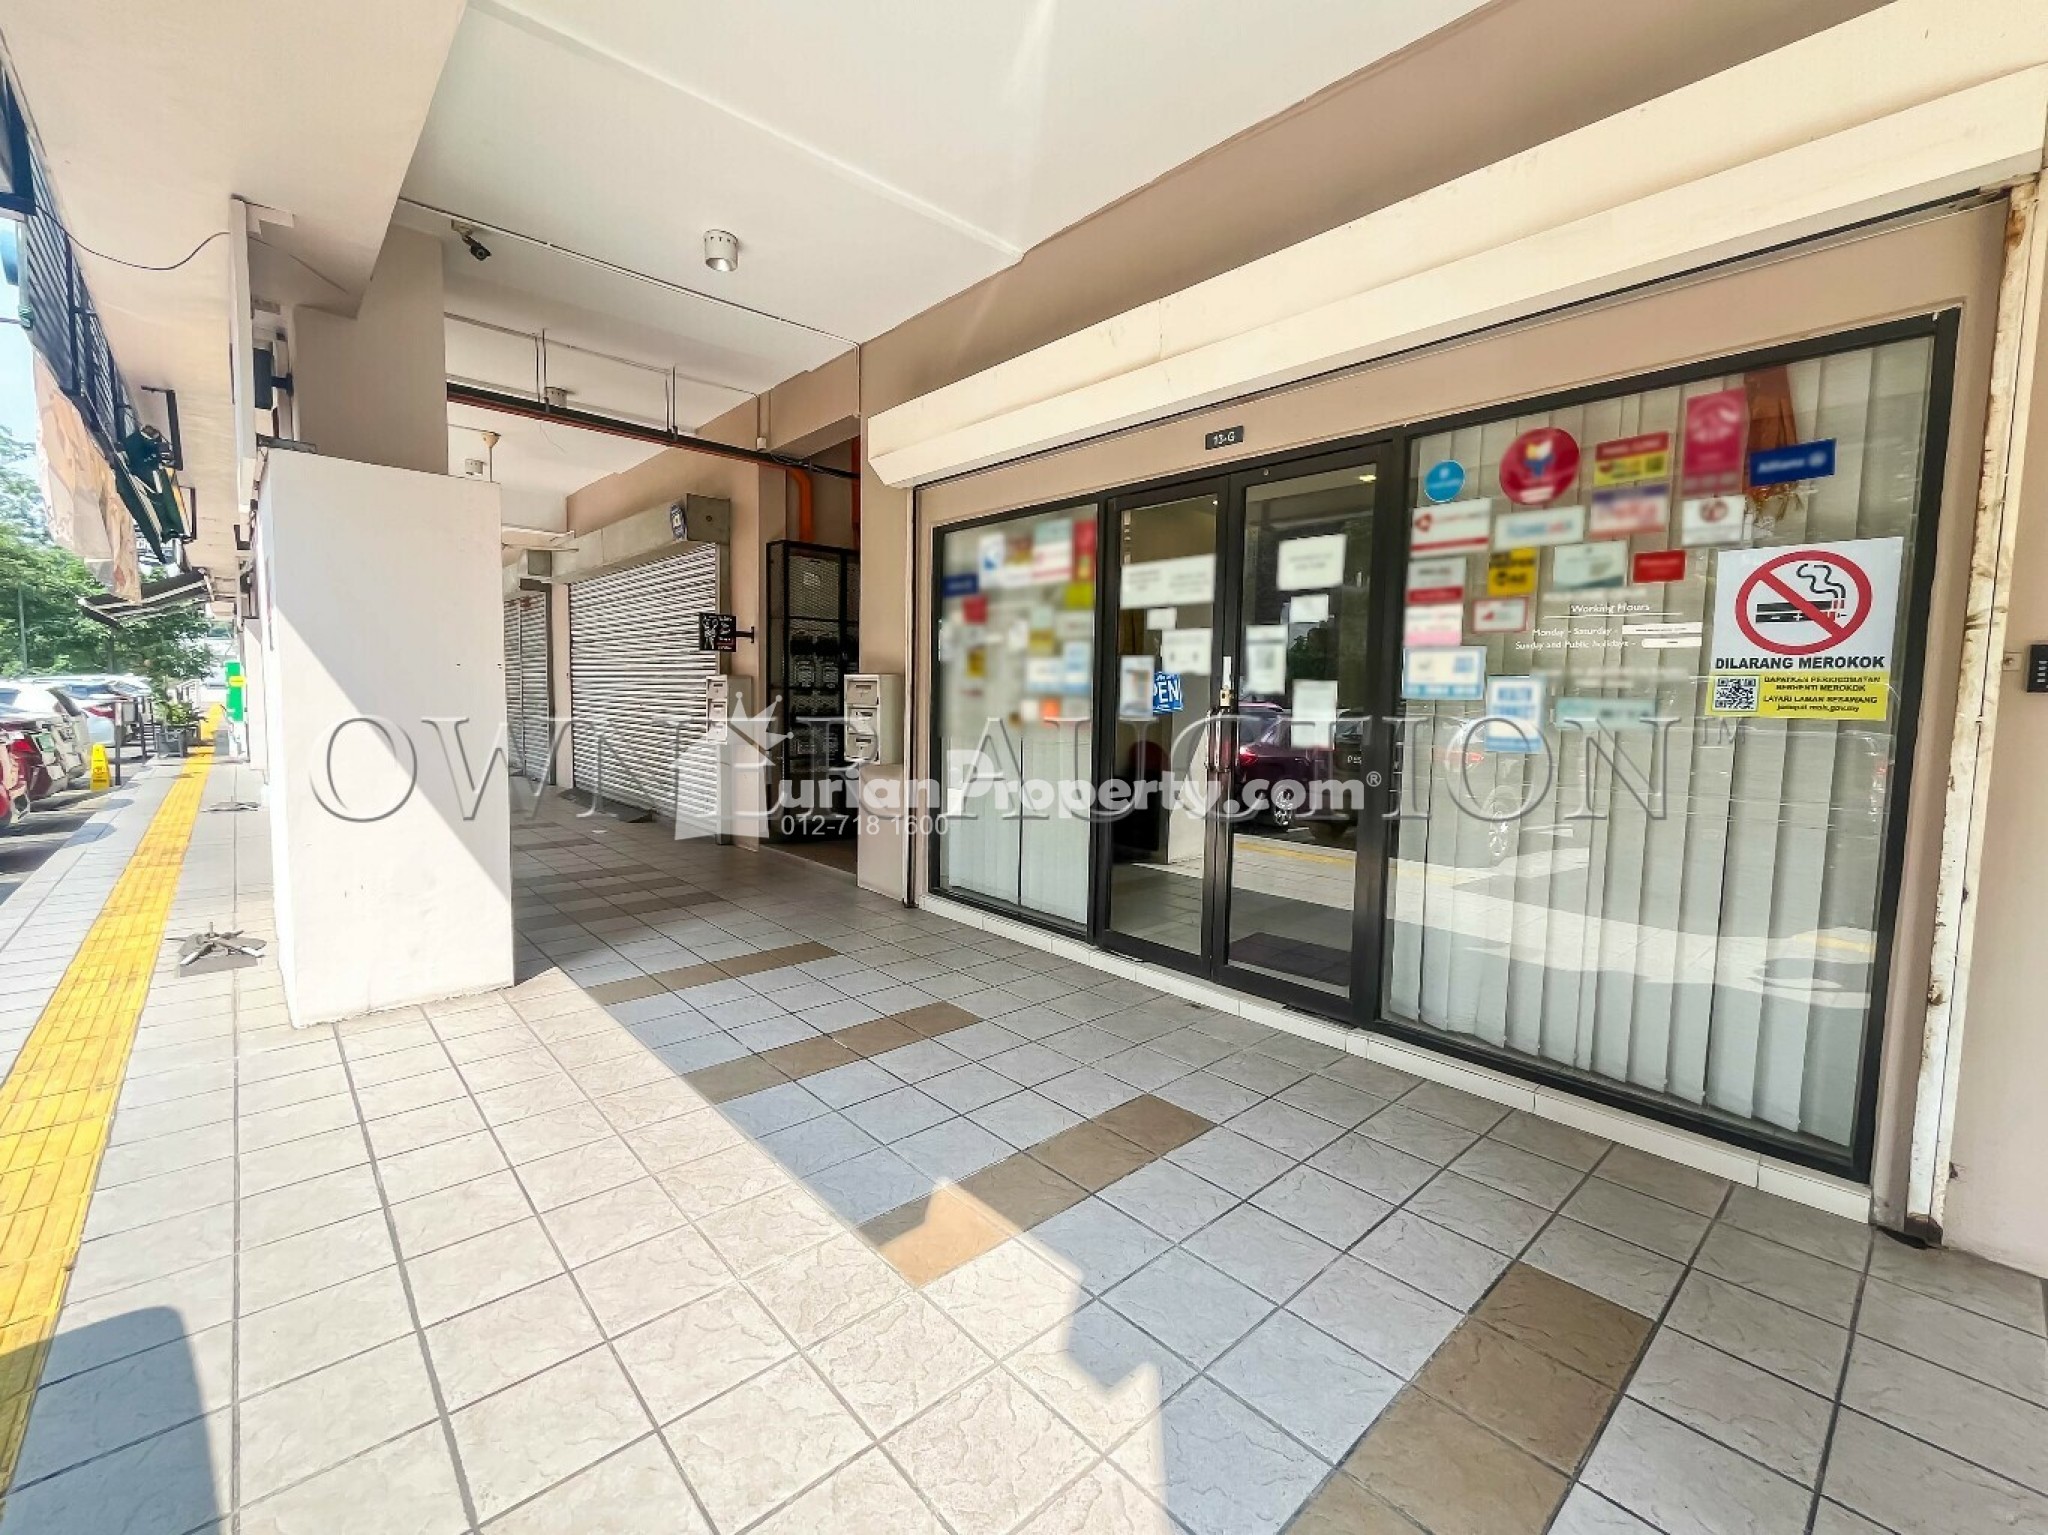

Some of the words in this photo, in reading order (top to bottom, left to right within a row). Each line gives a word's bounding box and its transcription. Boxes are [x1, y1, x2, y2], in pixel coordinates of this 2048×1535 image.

[1212, 431, 1235, 446] 13-G
[1570, 603, 1615, 614] Working
[1617, 603, 1650, 613] Hours
[1532, 628, 1565, 638] Monday
[1573, 627, 1612, 637] Saturday
[1515, 641, 1545, 650] Sunday
[1546, 641, 1562, 649] and
[1564, 640, 1589, 649] Public
[1715, 657, 1793, 670] DILARANG
[1798, 656, 1886, 670] MEROKOK
[1819, 684, 1866, 692] MEROKOK
